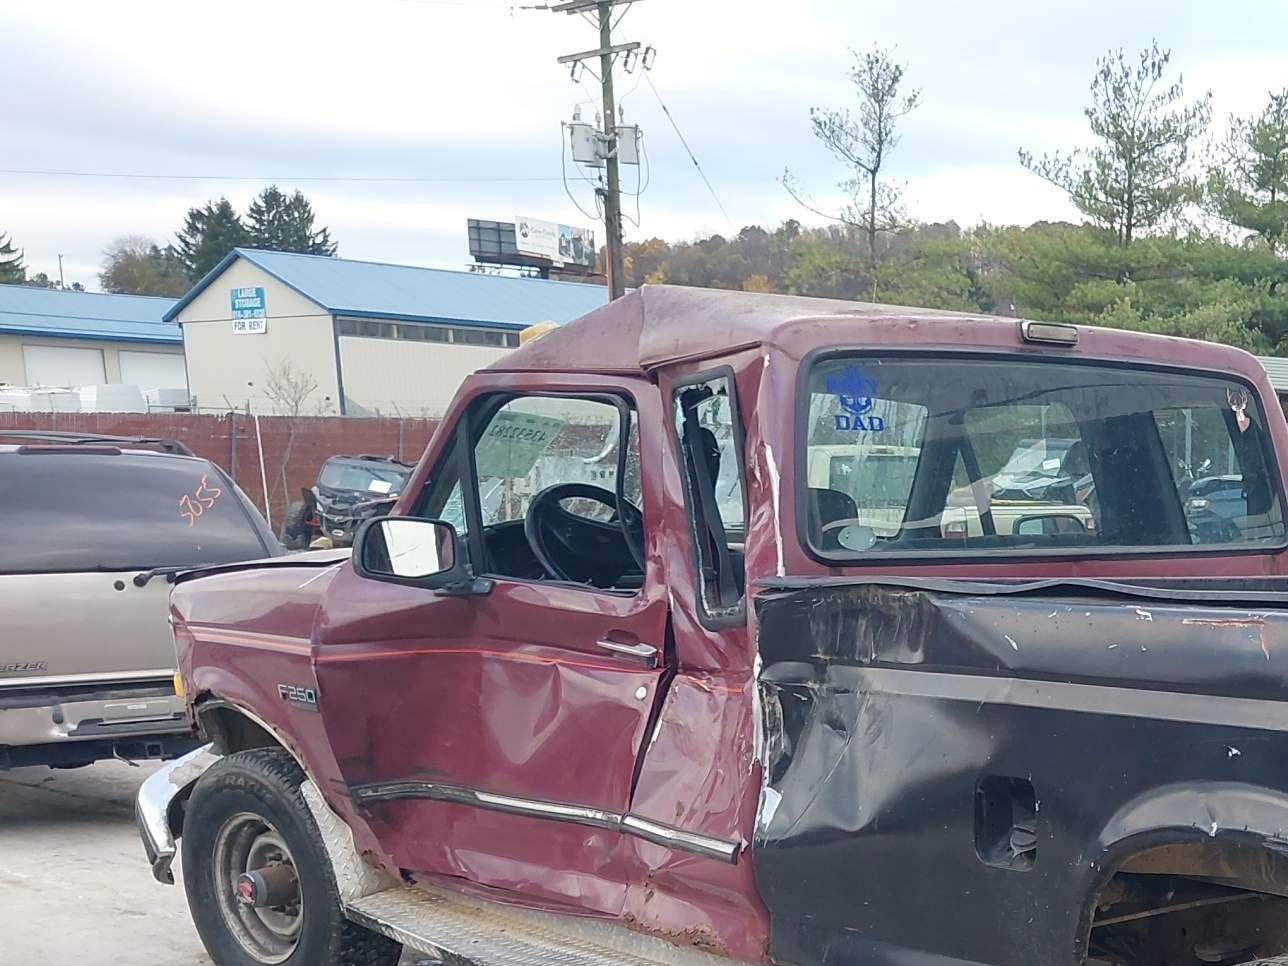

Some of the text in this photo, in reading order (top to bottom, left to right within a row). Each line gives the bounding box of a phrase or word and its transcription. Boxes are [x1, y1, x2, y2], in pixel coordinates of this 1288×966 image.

[234, 298, 262, 308] STORAGE
[234, 320, 264, 331] FOR RENT
[834, 415, 885, 432] DAD
[277, 683, 316, 703] F250
